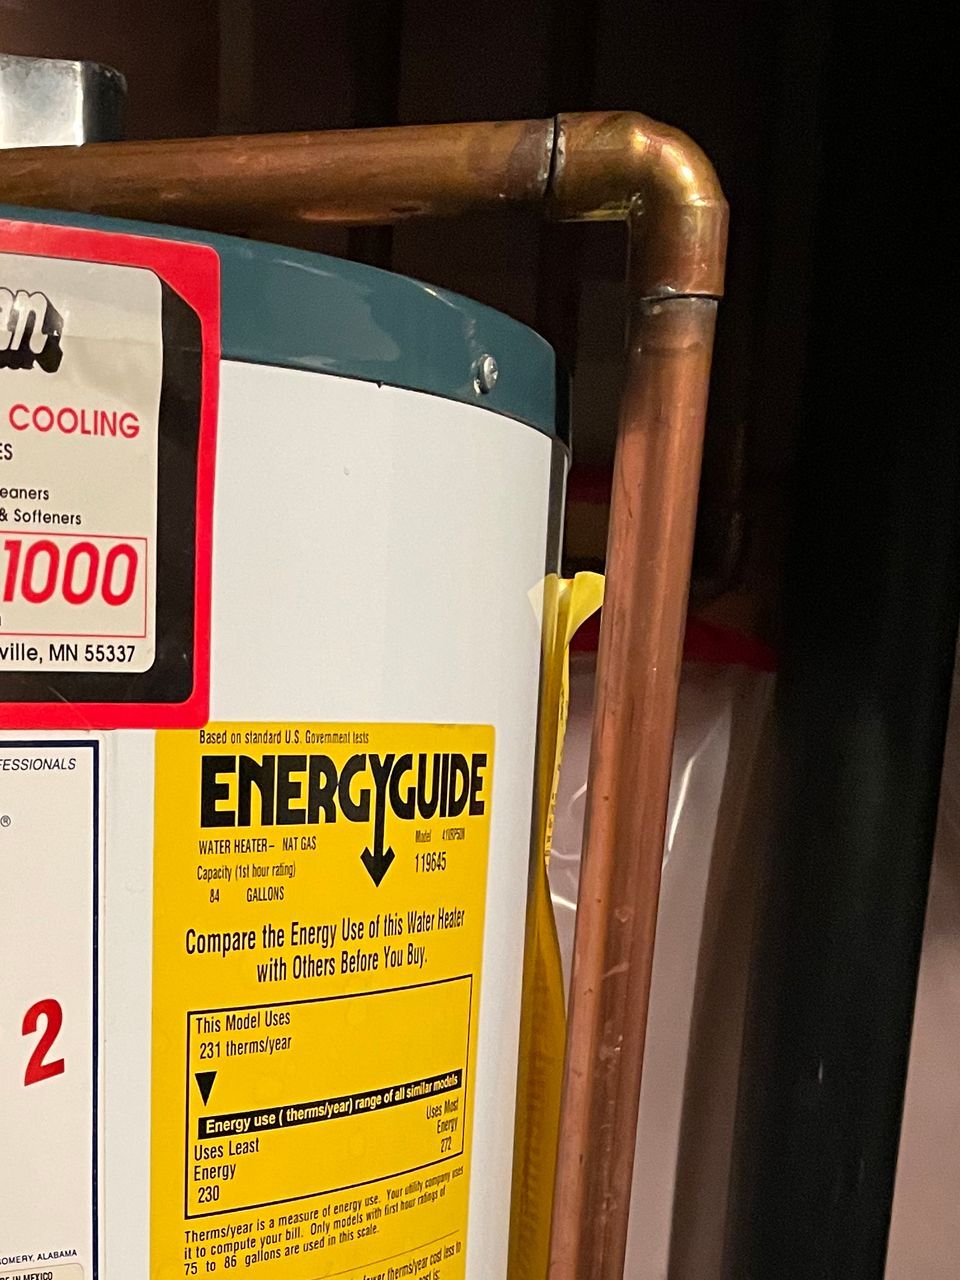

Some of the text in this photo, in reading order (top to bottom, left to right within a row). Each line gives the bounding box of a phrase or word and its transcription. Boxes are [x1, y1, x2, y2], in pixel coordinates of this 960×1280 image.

[9, 404, 140, 439] COOLING
[14, 508, 81, 525] Softeners
[49, 644, 78, 661] MN
[84, 644, 135, 662] 55337
[199, 729, 369, 744] Based on standard U.S. Government tests
[200, 753, 488, 829] ENERGYGUIDE
[199, 839, 231, 855] WATER
[282, 837, 298, 851] NAT
[301, 835, 317, 851] GAS
[415, 851, 446, 873] 119645
[209, 886, 284, 903] 84 GALLONS
[186, 906, 465, 957] Compare the Energy Use of this Water Heater
[257, 942, 427, 983] with Others Before You Buy.
[195, 1010, 290, 1034] This Model Uses
[21, 997, 66, 1088] 2
[200, 1036, 292, 1059] 231 therms/year
[194, 1137, 259, 1161] Uses Least
[37, 1249, 77, 1261] ALABAMA
